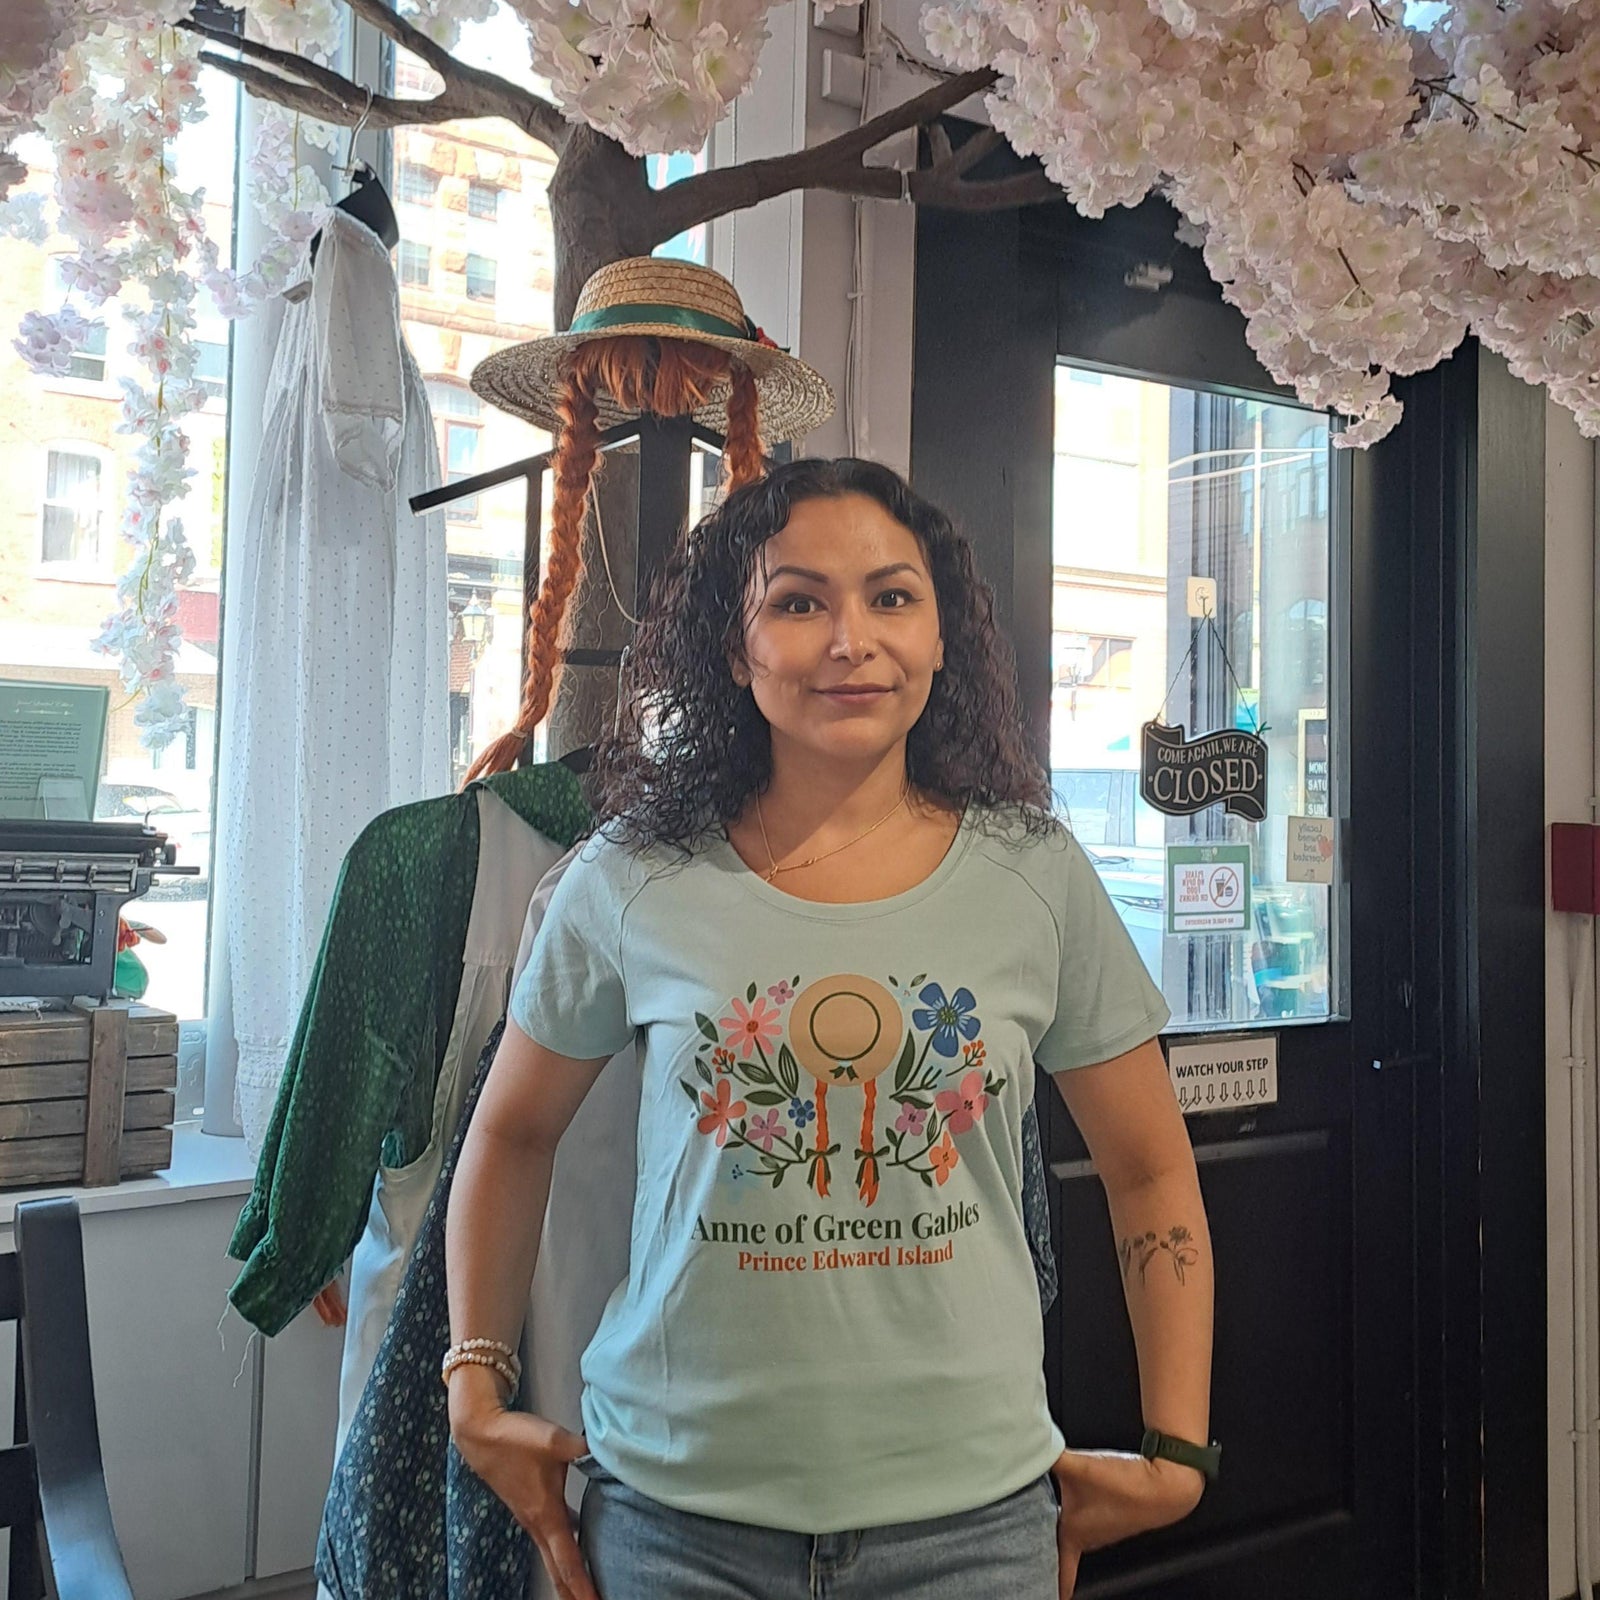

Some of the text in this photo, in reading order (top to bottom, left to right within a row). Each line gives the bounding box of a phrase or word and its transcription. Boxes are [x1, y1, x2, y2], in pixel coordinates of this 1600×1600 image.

[1157, 746, 1186, 764] COME
[1222, 738, 1237, 753] WE
[1238, 740, 1258, 758] ARE
[1153, 758, 1258, 804] CLOSED
[1176, 1057, 1269, 1079] WATCH YOUR STEP
[691, 1200, 980, 1244] Anne of Green Gables
[738, 1240, 954, 1272] Prince Edward Island
